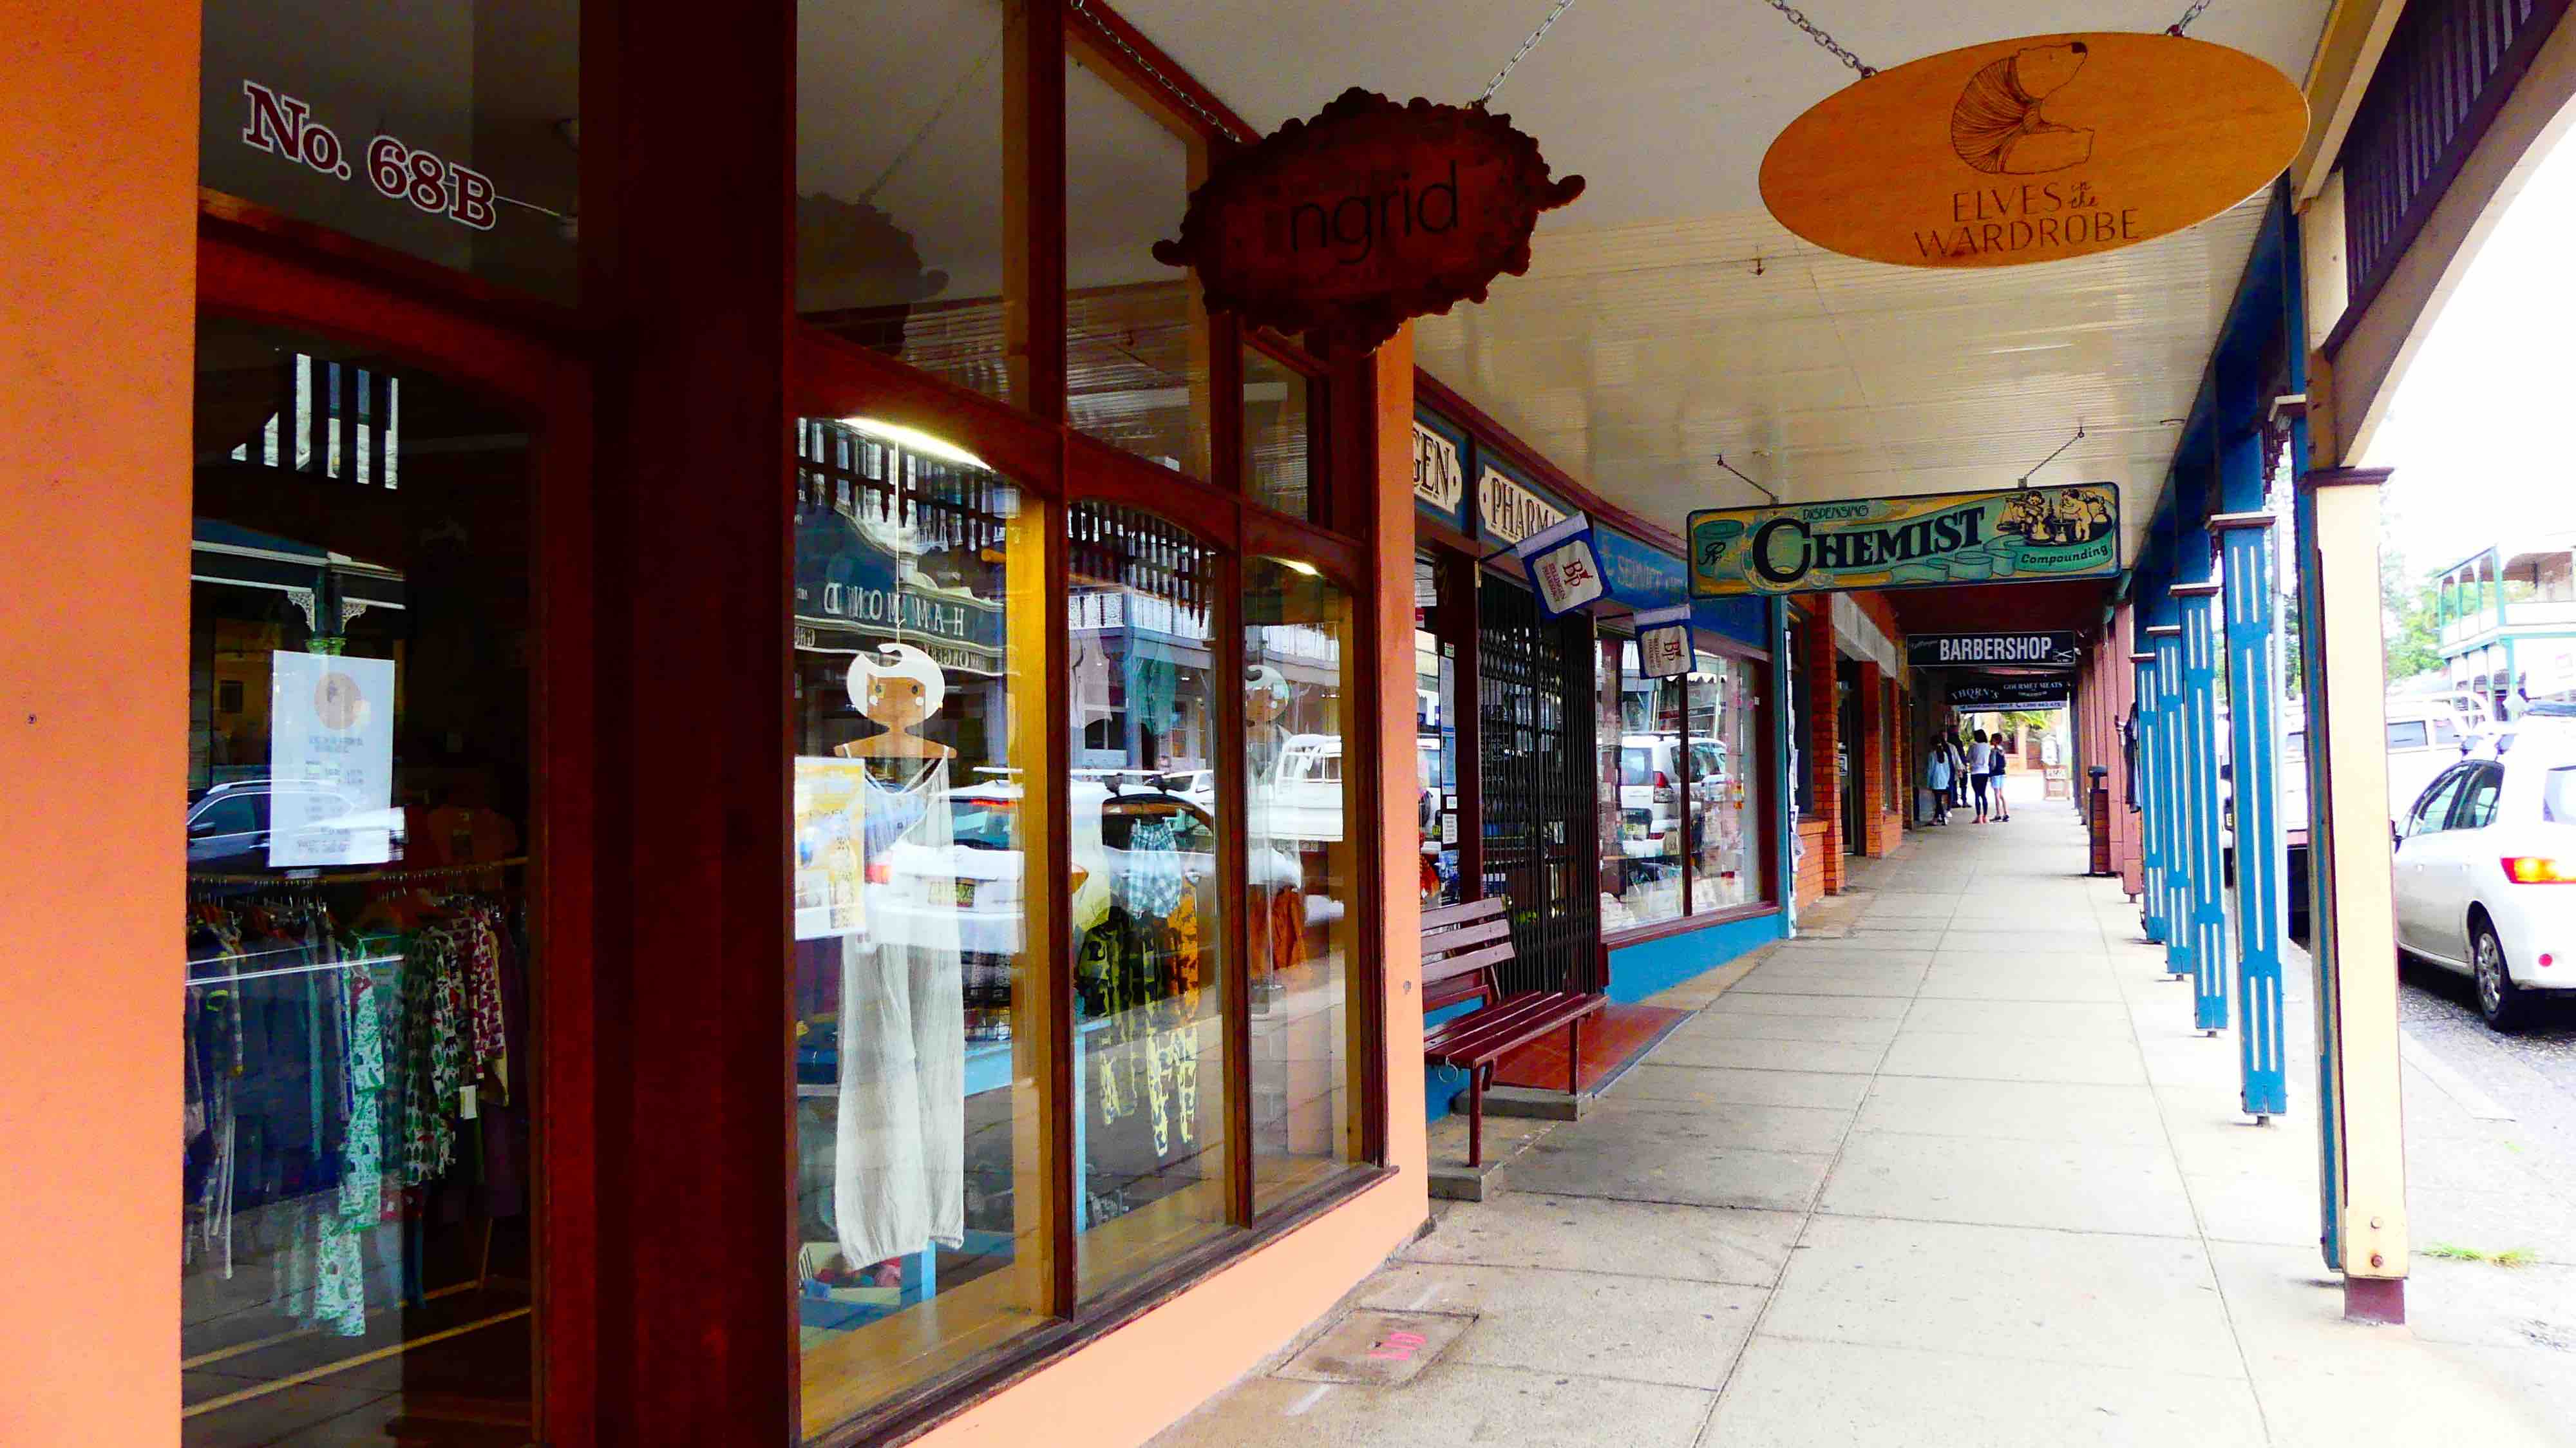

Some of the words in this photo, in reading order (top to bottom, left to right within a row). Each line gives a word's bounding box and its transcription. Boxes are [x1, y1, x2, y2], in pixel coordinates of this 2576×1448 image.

[243, 79, 350, 180] No.
[367, 135, 496, 231] 68B
[2069, 193, 2099, 209] the
[2071, 181, 2091, 191] in
[1953, 182, 2061, 222] ELVES
[1914, 208, 2139, 258] WARDROBE
[1752, 506, 1985, 582] CHEMIST
[2021, 544, 2108, 566] Compounding
[1940, 637, 2052, 660] BARBERSHOP
